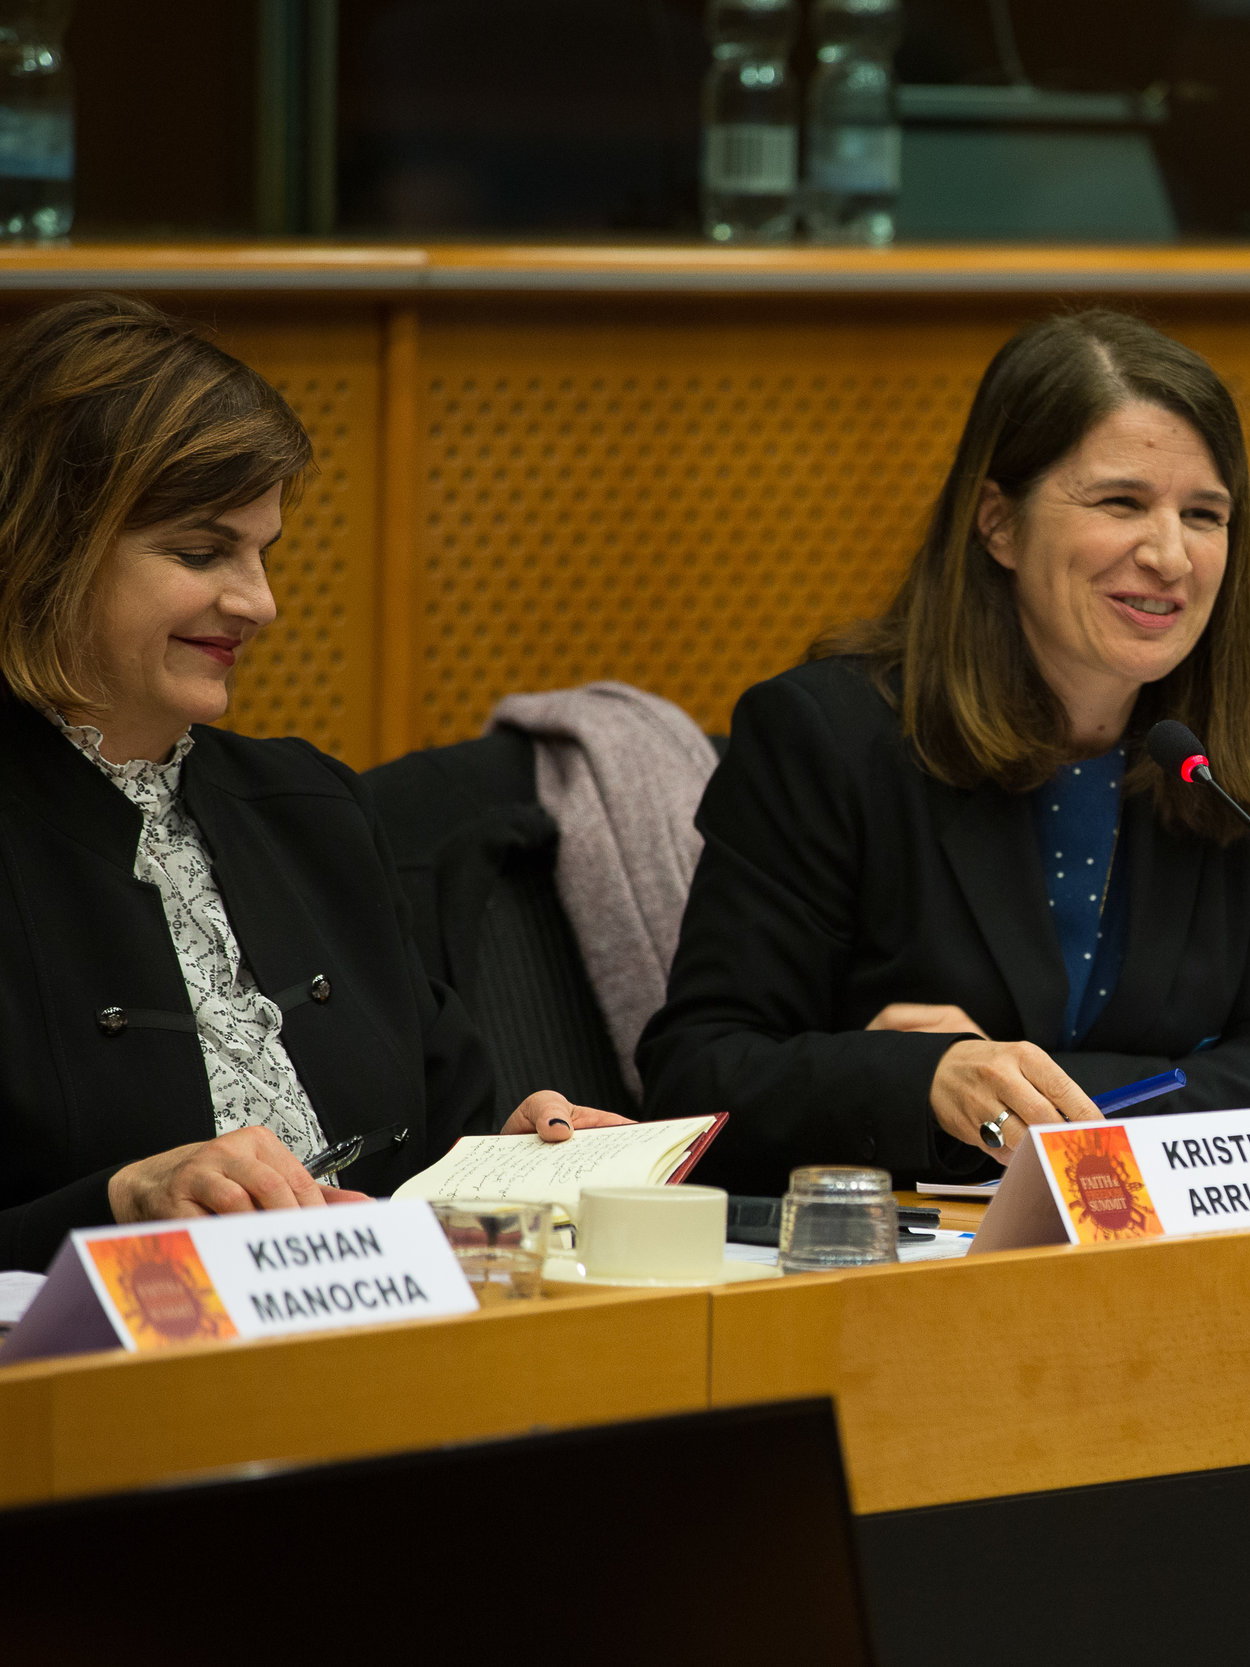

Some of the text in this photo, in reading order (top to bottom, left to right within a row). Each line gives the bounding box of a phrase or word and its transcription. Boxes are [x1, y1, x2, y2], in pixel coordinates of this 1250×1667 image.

[1079, 1176, 1112, 1189] FAITH
[1089, 1198, 1127, 1211] SUMMIT
[246, 1227, 384, 1272] KISHAN
[250, 1274, 428, 1323] MANOCHA
